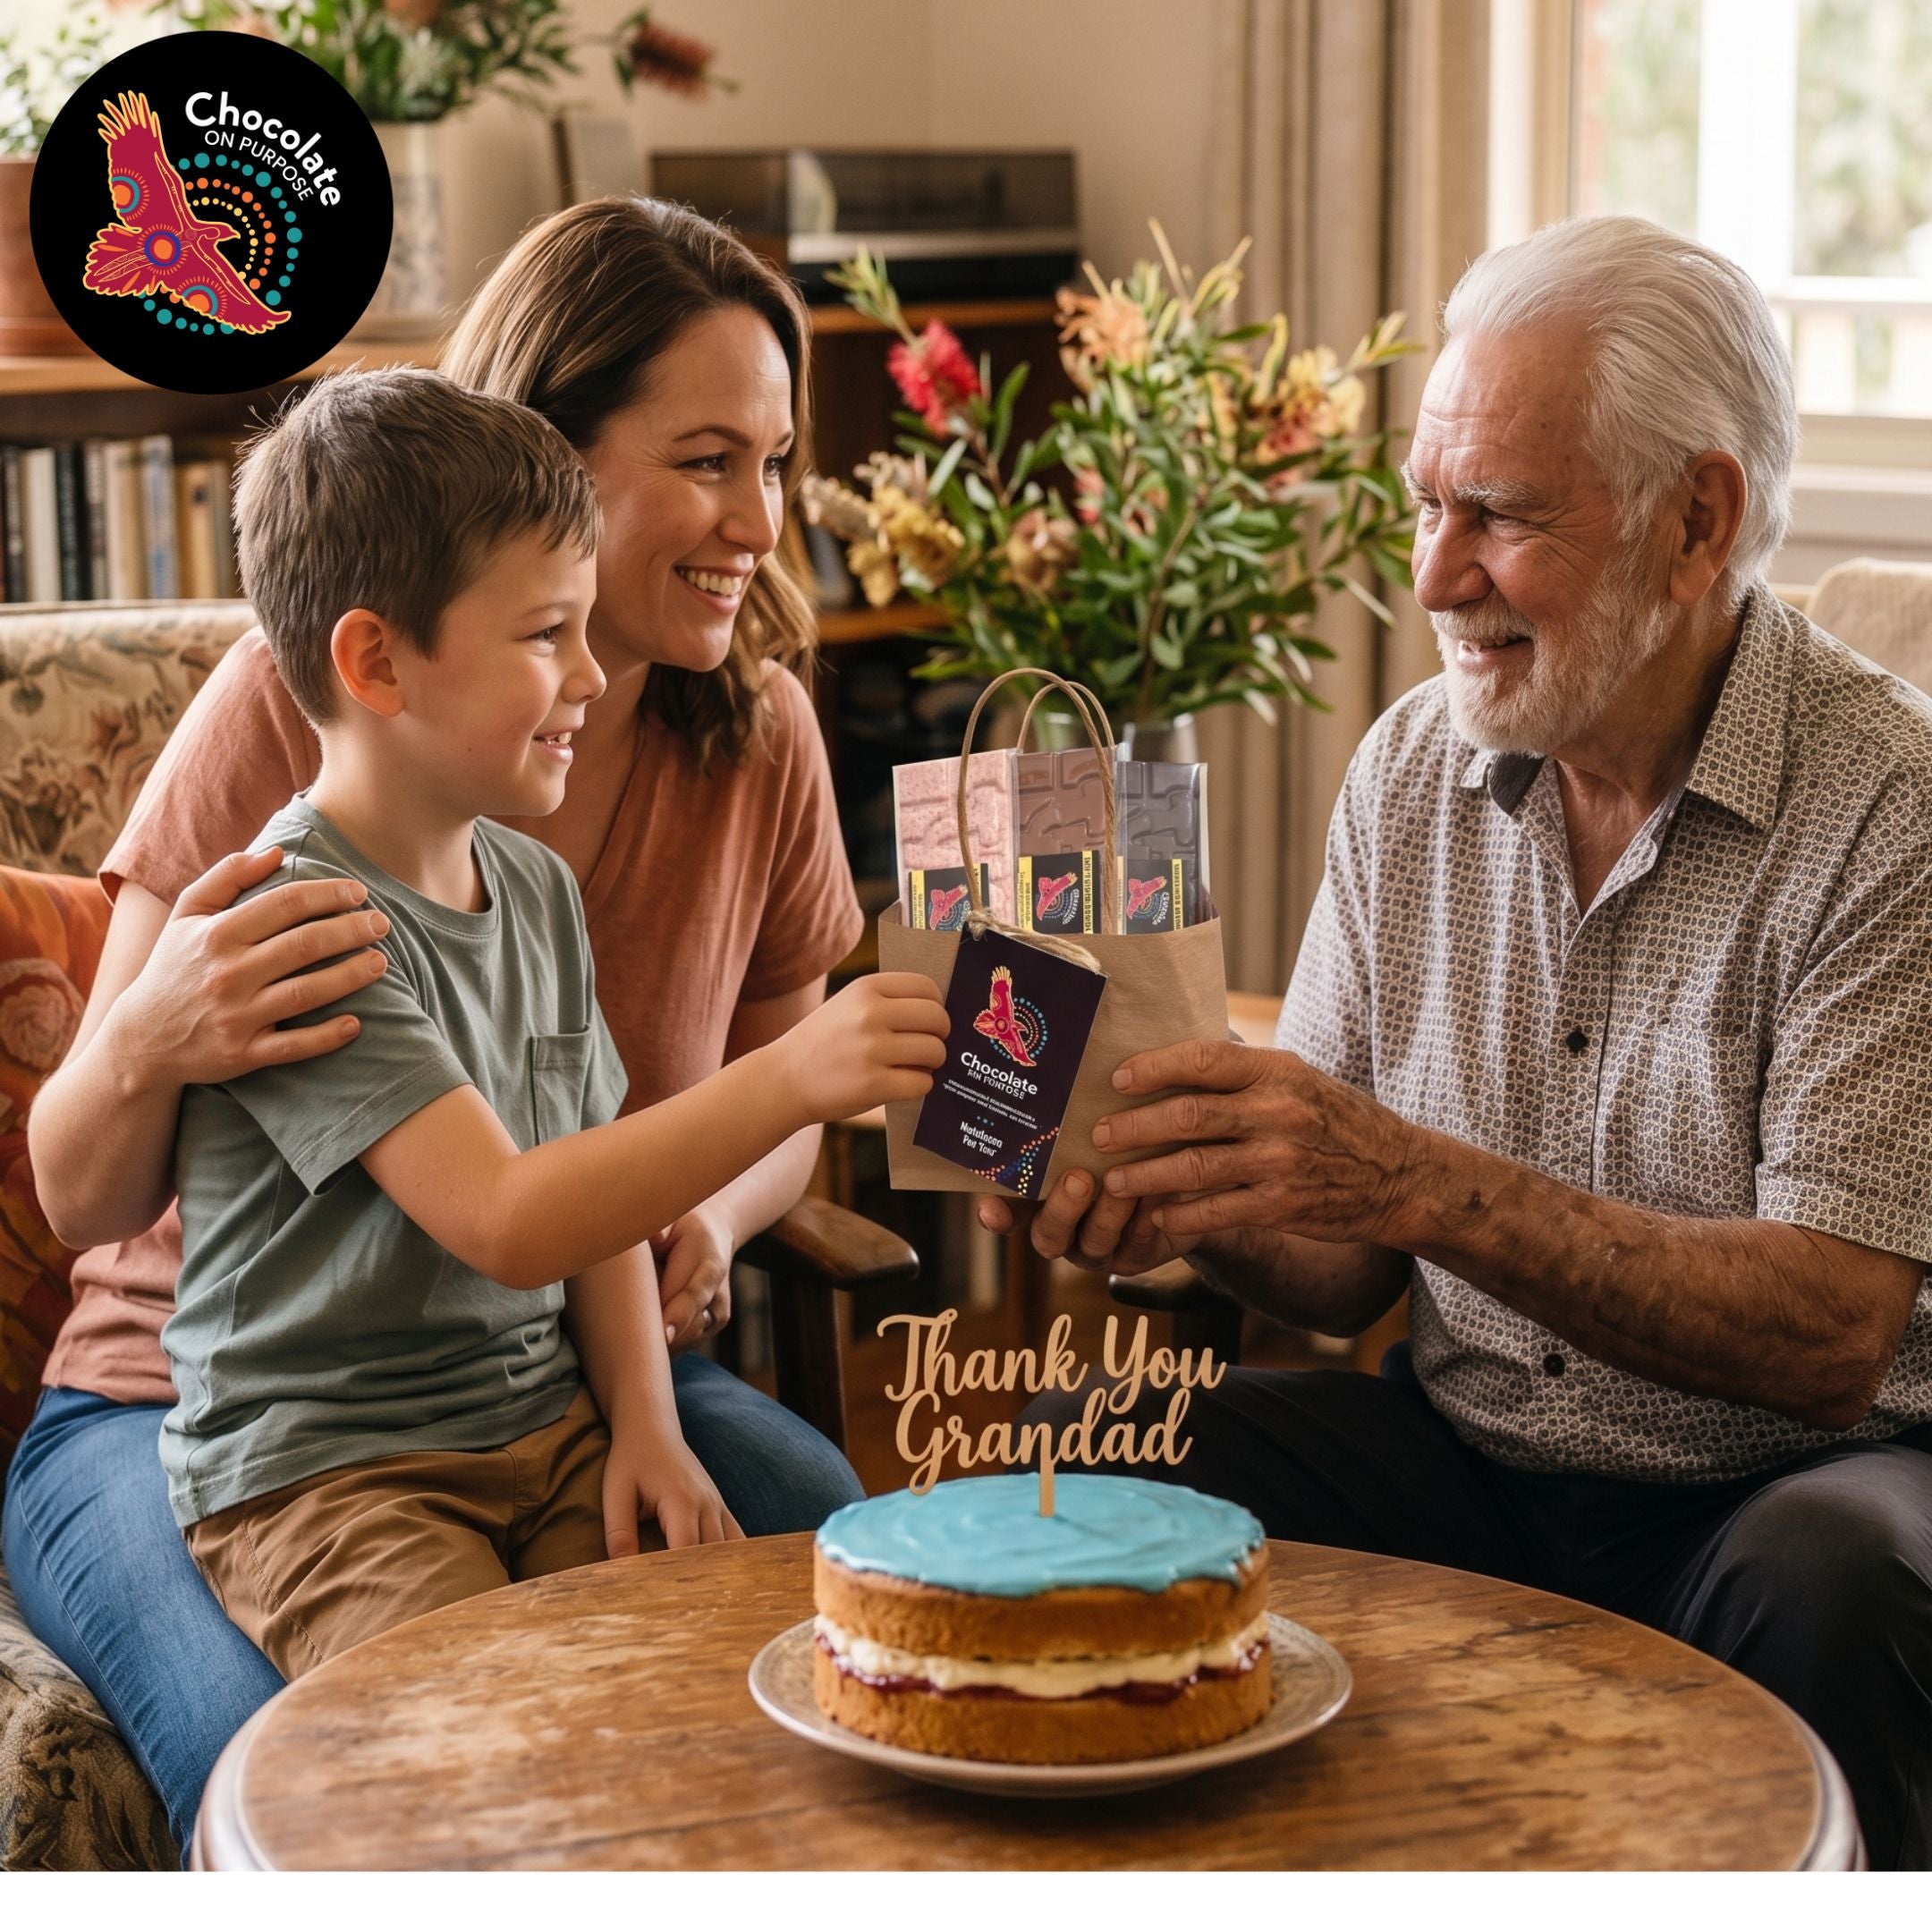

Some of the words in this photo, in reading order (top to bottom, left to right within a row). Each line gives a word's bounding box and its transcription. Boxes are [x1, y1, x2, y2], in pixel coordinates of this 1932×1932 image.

[961, 1051, 1038, 1095] Chocolate
[877, 1308, 1089, 1402] Thank
[1103, 1315, 1226, 1415] You
[895, 1387, 1193, 1496] Grandad
